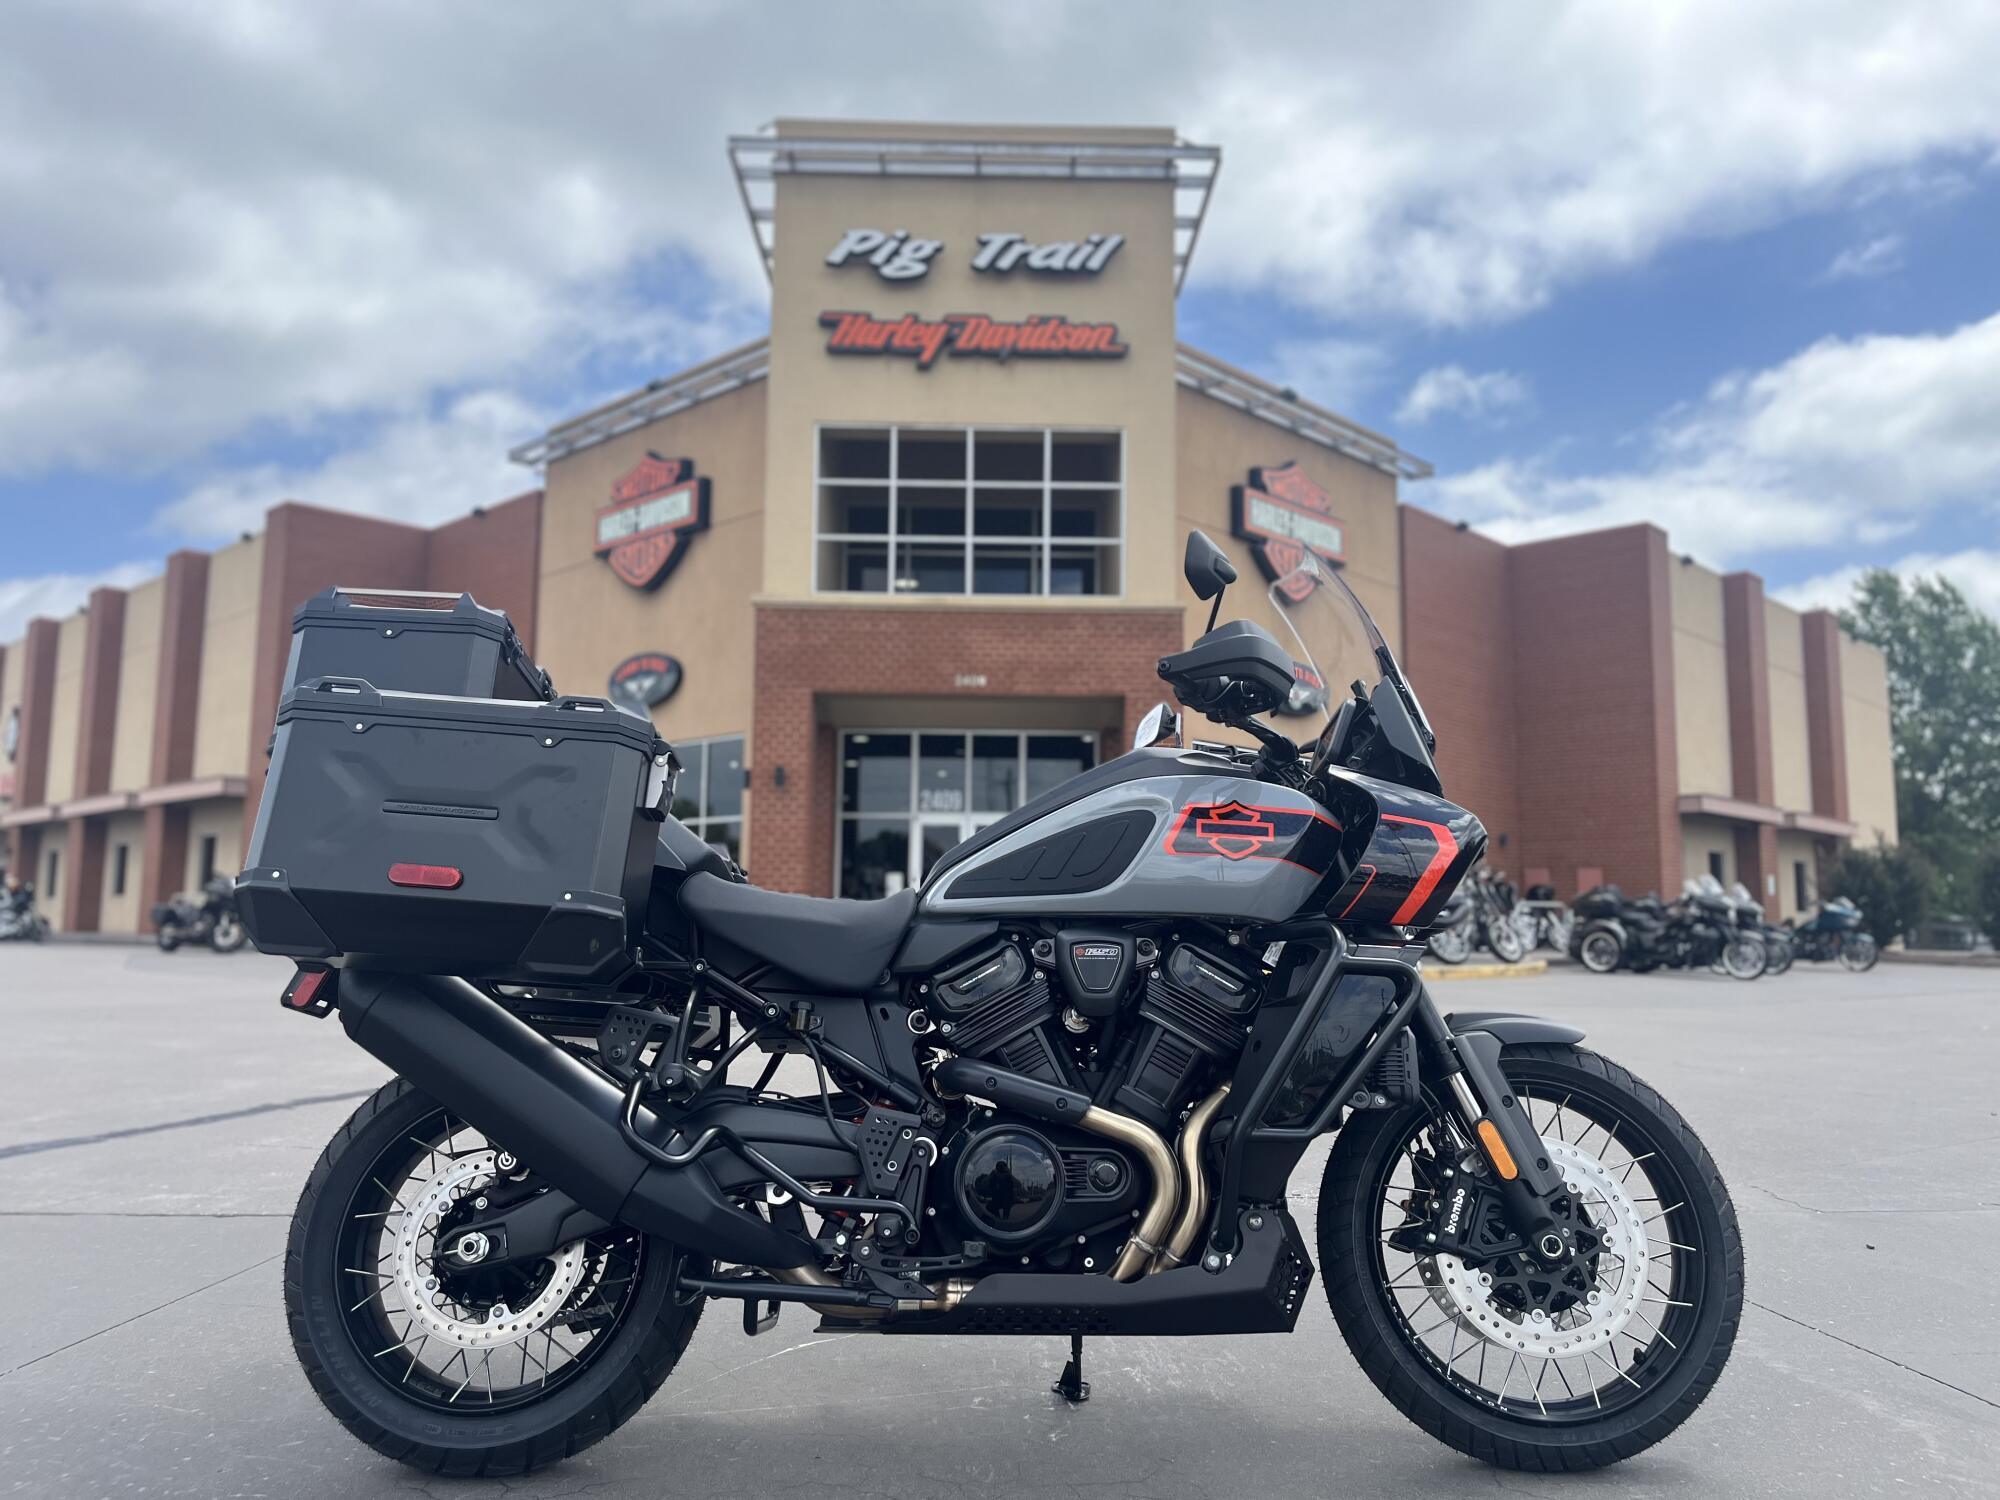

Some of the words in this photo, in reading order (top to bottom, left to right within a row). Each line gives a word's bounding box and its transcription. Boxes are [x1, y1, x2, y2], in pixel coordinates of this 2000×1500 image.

[825, 229, 942, 281] Pig
[972, 233, 1123, 273] Trail
[819, 311, 1128, 369] Harley-Davidson
[1444, 1188, 1466, 1234] brembo
